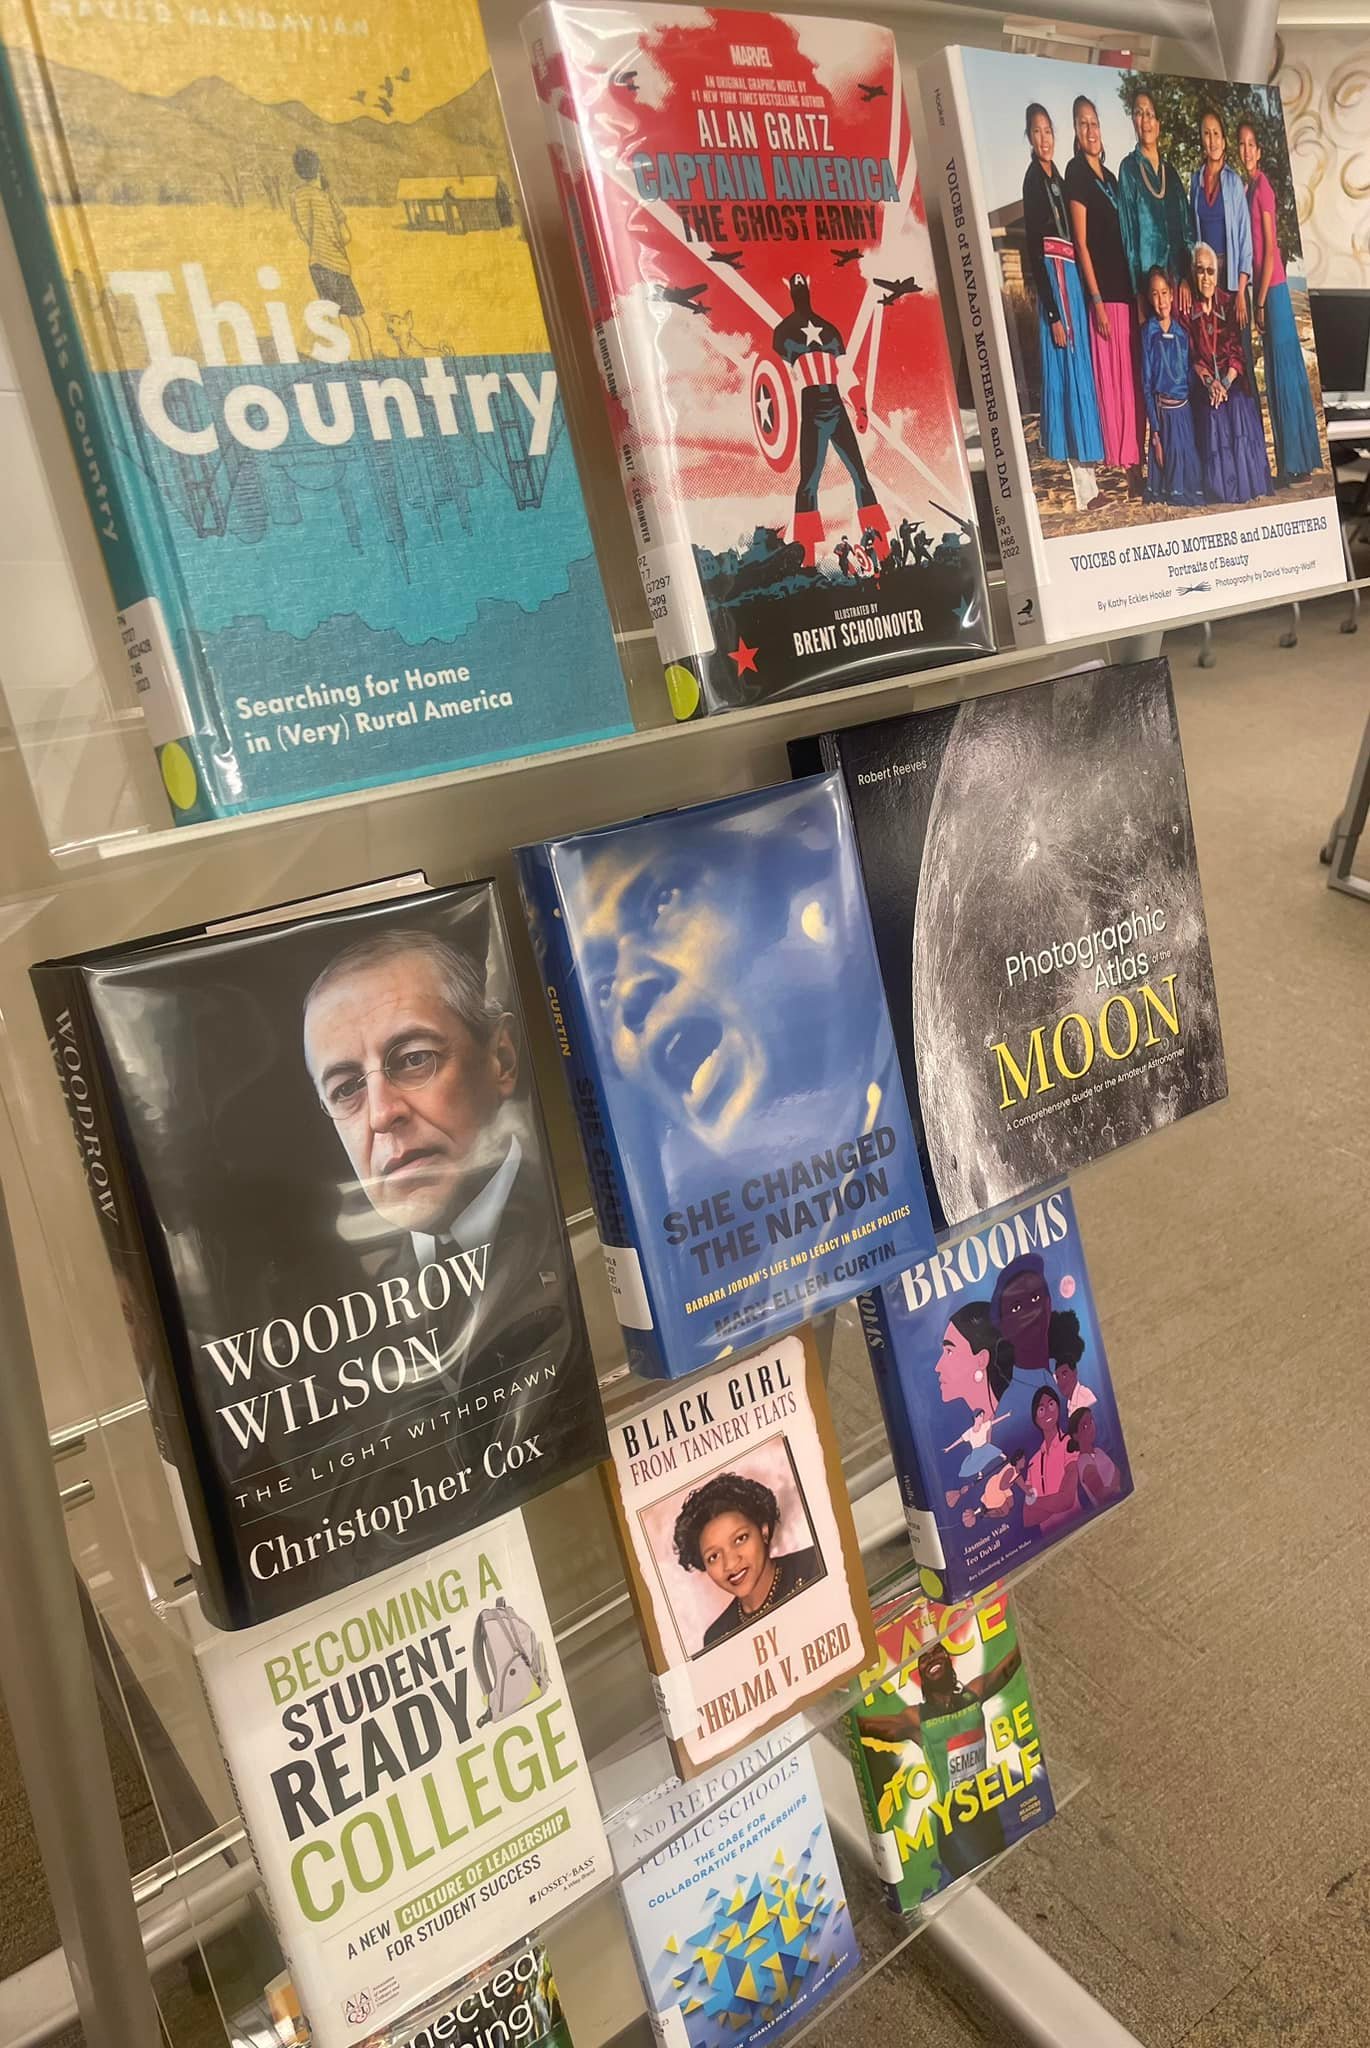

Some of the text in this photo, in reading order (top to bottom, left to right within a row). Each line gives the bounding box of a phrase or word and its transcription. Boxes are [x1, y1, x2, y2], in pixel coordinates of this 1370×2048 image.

[705, 75, 807, 93] AN ORIGINAL GRAPHIC NOVEL BY
[729, 44, 773, 68] MARVEL
[691, 90, 826, 109] #1 NEW YORK TIMES BESTSELLING AUTHOR
[697, 109, 835, 151] ALAN GRATZ
[633, 152, 901, 203] CAPTAIN AMERICA
[676, 204, 878, 243] THE GHOST ARMY
[109, 263, 351, 366] This
[945, 156, 1005, 460] VOICES of NAVAJO MOTHERS and
[42, 282, 119, 541] This Country
[137, 356, 558, 456] Country
[622, 444, 651, 545] GRATZ SCHOONOVER
[646, 575, 671, 594] G7297
[1001, 545, 1020, 559] 2022
[1069, 516, 1328, 572] VOICES of NAVAJO MOTHERS and DAUGHTERS
[1167, 553, 1250, 578] Portraits of Beauty
[1215, 573, 1254, 588] Photography
[1254, 570, 1263, 581] by
[1262, 567, 1281, 579] David
[793, 609, 924, 657] BRENT SCHOONOVER
[834, 603, 878, 620] ILLUSTRATED BY
[1097, 589, 1172, 611] By Kathy Eckles Hooker
[235, 666, 471, 720] Searching for Home
[245, 690, 514, 754] in (Very) Rural America
[857, 758, 928, 786] Robert Reeves
[1005, 905, 1168, 987] Photographic
[1094, 950, 1172, 993] Atlas of the
[547, 985, 572, 1057] CURTIN
[988, 974, 1181, 1110] MOON
[54, 1007, 120, 1225] WOODROW
[1006, 1047, 1185, 1133] A Comprehensive Guide for the Amateur Astronomer
[662, 1126, 897, 1246] SHE CHANGED
[690, 1222, 761, 1277] THE
[765, 1167, 890, 1245] NATION
[685, 1204, 911, 1315] BARBARA JORDAN'S LIFE AND LEGACY IN BLACK POLITICS
[772, 1272, 830, 1310] ELLEN
[833, 1240, 897, 1283] CURTIN
[901, 1193, 1069, 1312] BROOMS
[200, 1243, 492, 1387] WOODROW
[215, 1327, 445, 1451] WILSON
[621, 1358, 792, 1459] BLACK GIRL
[234, 1364, 558, 1509] THE LIGHT WITHDRAWN
[629, 1391, 798, 1487] FROM TANNERY FLATS
[248, 1434, 545, 1581] Christopher Cox
[963, 1535, 992, 1556] Jasmine
[966, 1540, 1001, 1567] Teo DuVall
[263, 1569, 470, 1706] BECOMING
[477, 1552, 504, 1600] A
[752, 1626, 779, 1667] BY
[779, 1656, 799, 1688] V.
[800, 1622, 852, 1676] REED
[858, 1581, 1008, 1707] RACE
[911, 1610, 937, 1631] THE
[281, 1624, 466, 1752] STUDENT-
[270, 1667, 473, 1842] READY
[632, 1819, 668, 1848] AND
[668, 1739, 776, 1826] REFORM
[777, 1731, 793, 1752] IN
[718, 1756, 800, 1829] SCHOOLS
[883, 1762, 934, 1811] TO
[991, 1699, 1034, 1753] BE
[290, 1700, 579, 1924] COLLEGE
[693, 1813, 767, 1868] THE CASE FOR
[893, 1738, 1041, 1863] MYSELF
[348, 1813, 565, 1961] A NEW CULTURE OF LEADERSHIP
[537, 1857, 595, 1901] JOSSEY-BASS
[648, 1850, 738, 1909] COLLABORATIVE
[739, 1793, 808, 1854] PARTNERSHIPS
[386, 1854, 542, 1962] FOR STUDENT SUCCESS
